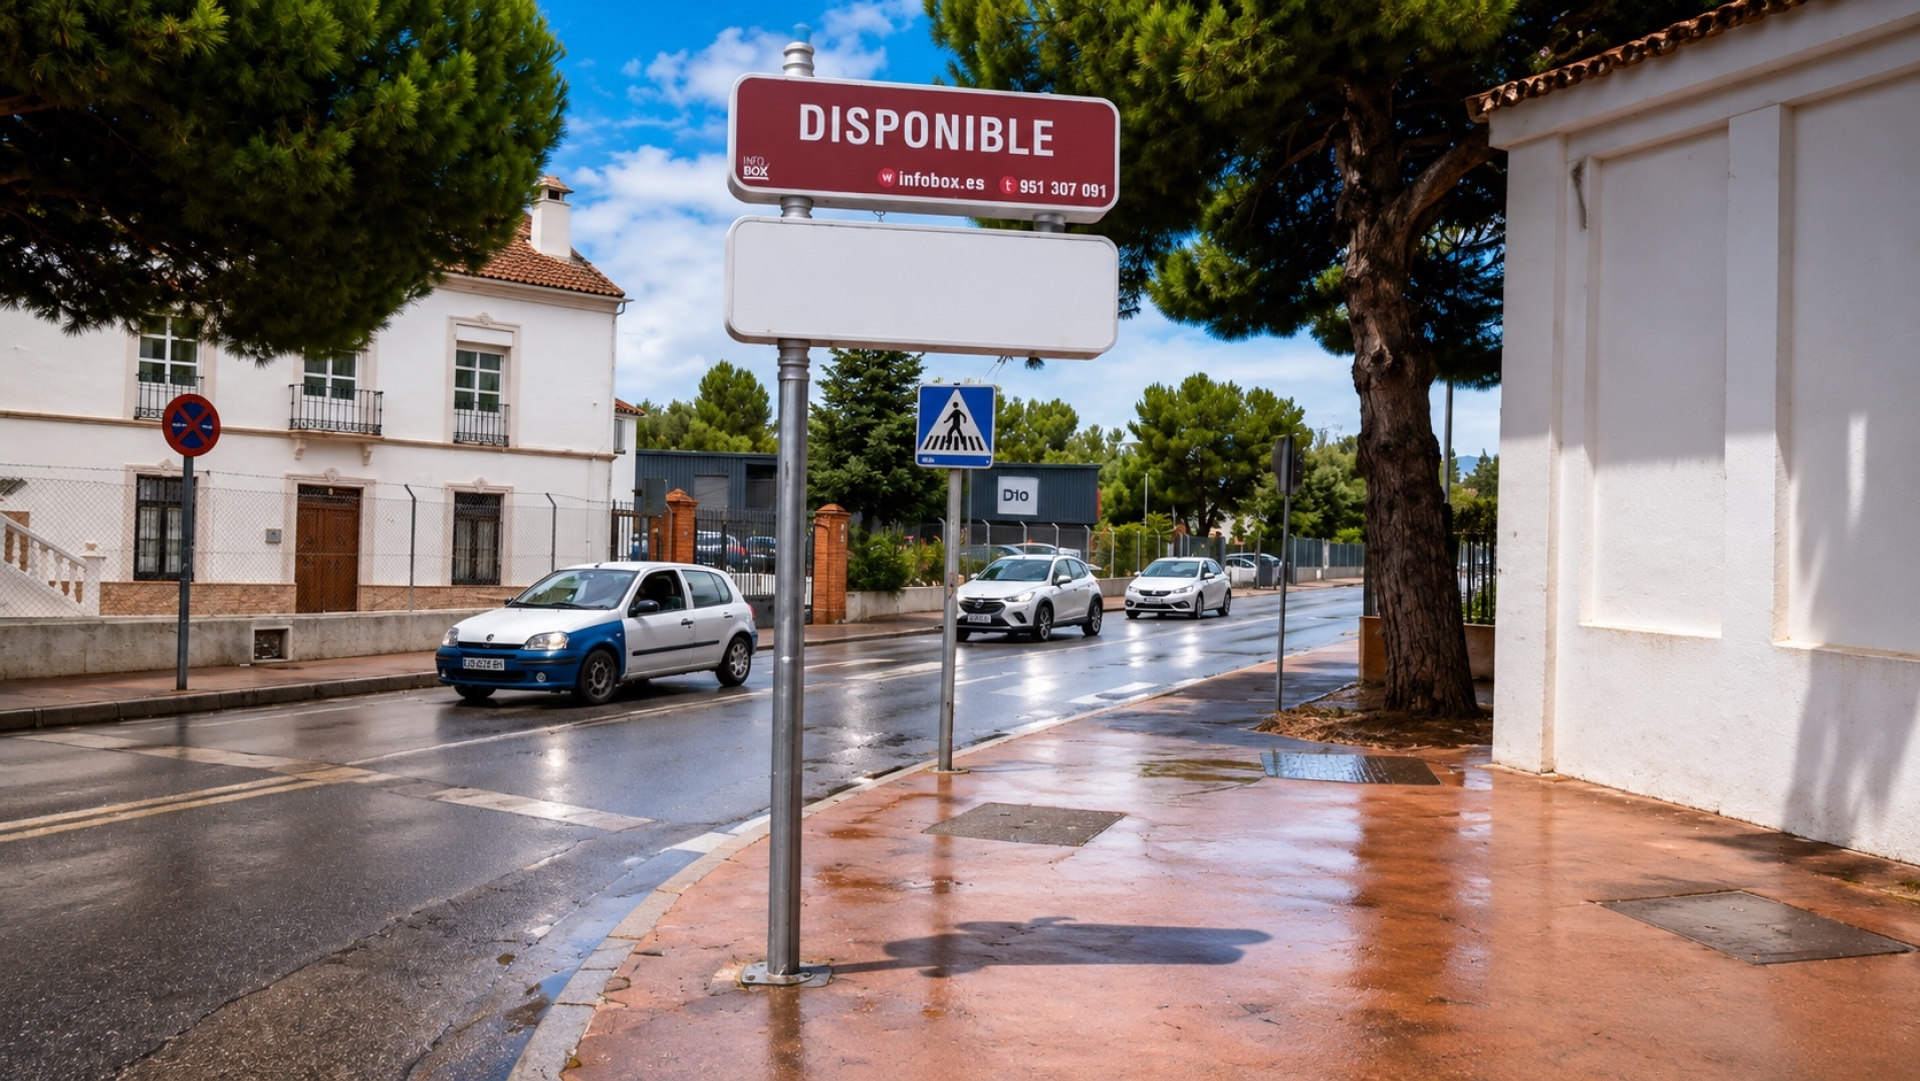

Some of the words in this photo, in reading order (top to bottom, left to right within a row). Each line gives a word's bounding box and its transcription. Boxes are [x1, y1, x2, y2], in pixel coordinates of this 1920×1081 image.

[799, 103, 1054, 157] DISPONIBLE
[743, 156, 765, 166] INFO
[743, 164, 769, 176] BOX
[899, 171, 985, 191] infobox.es
[1020, 179, 1044, 194] 951
[1051, 181, 1077, 197] 307
[1082, 183, 1107, 199] 091
